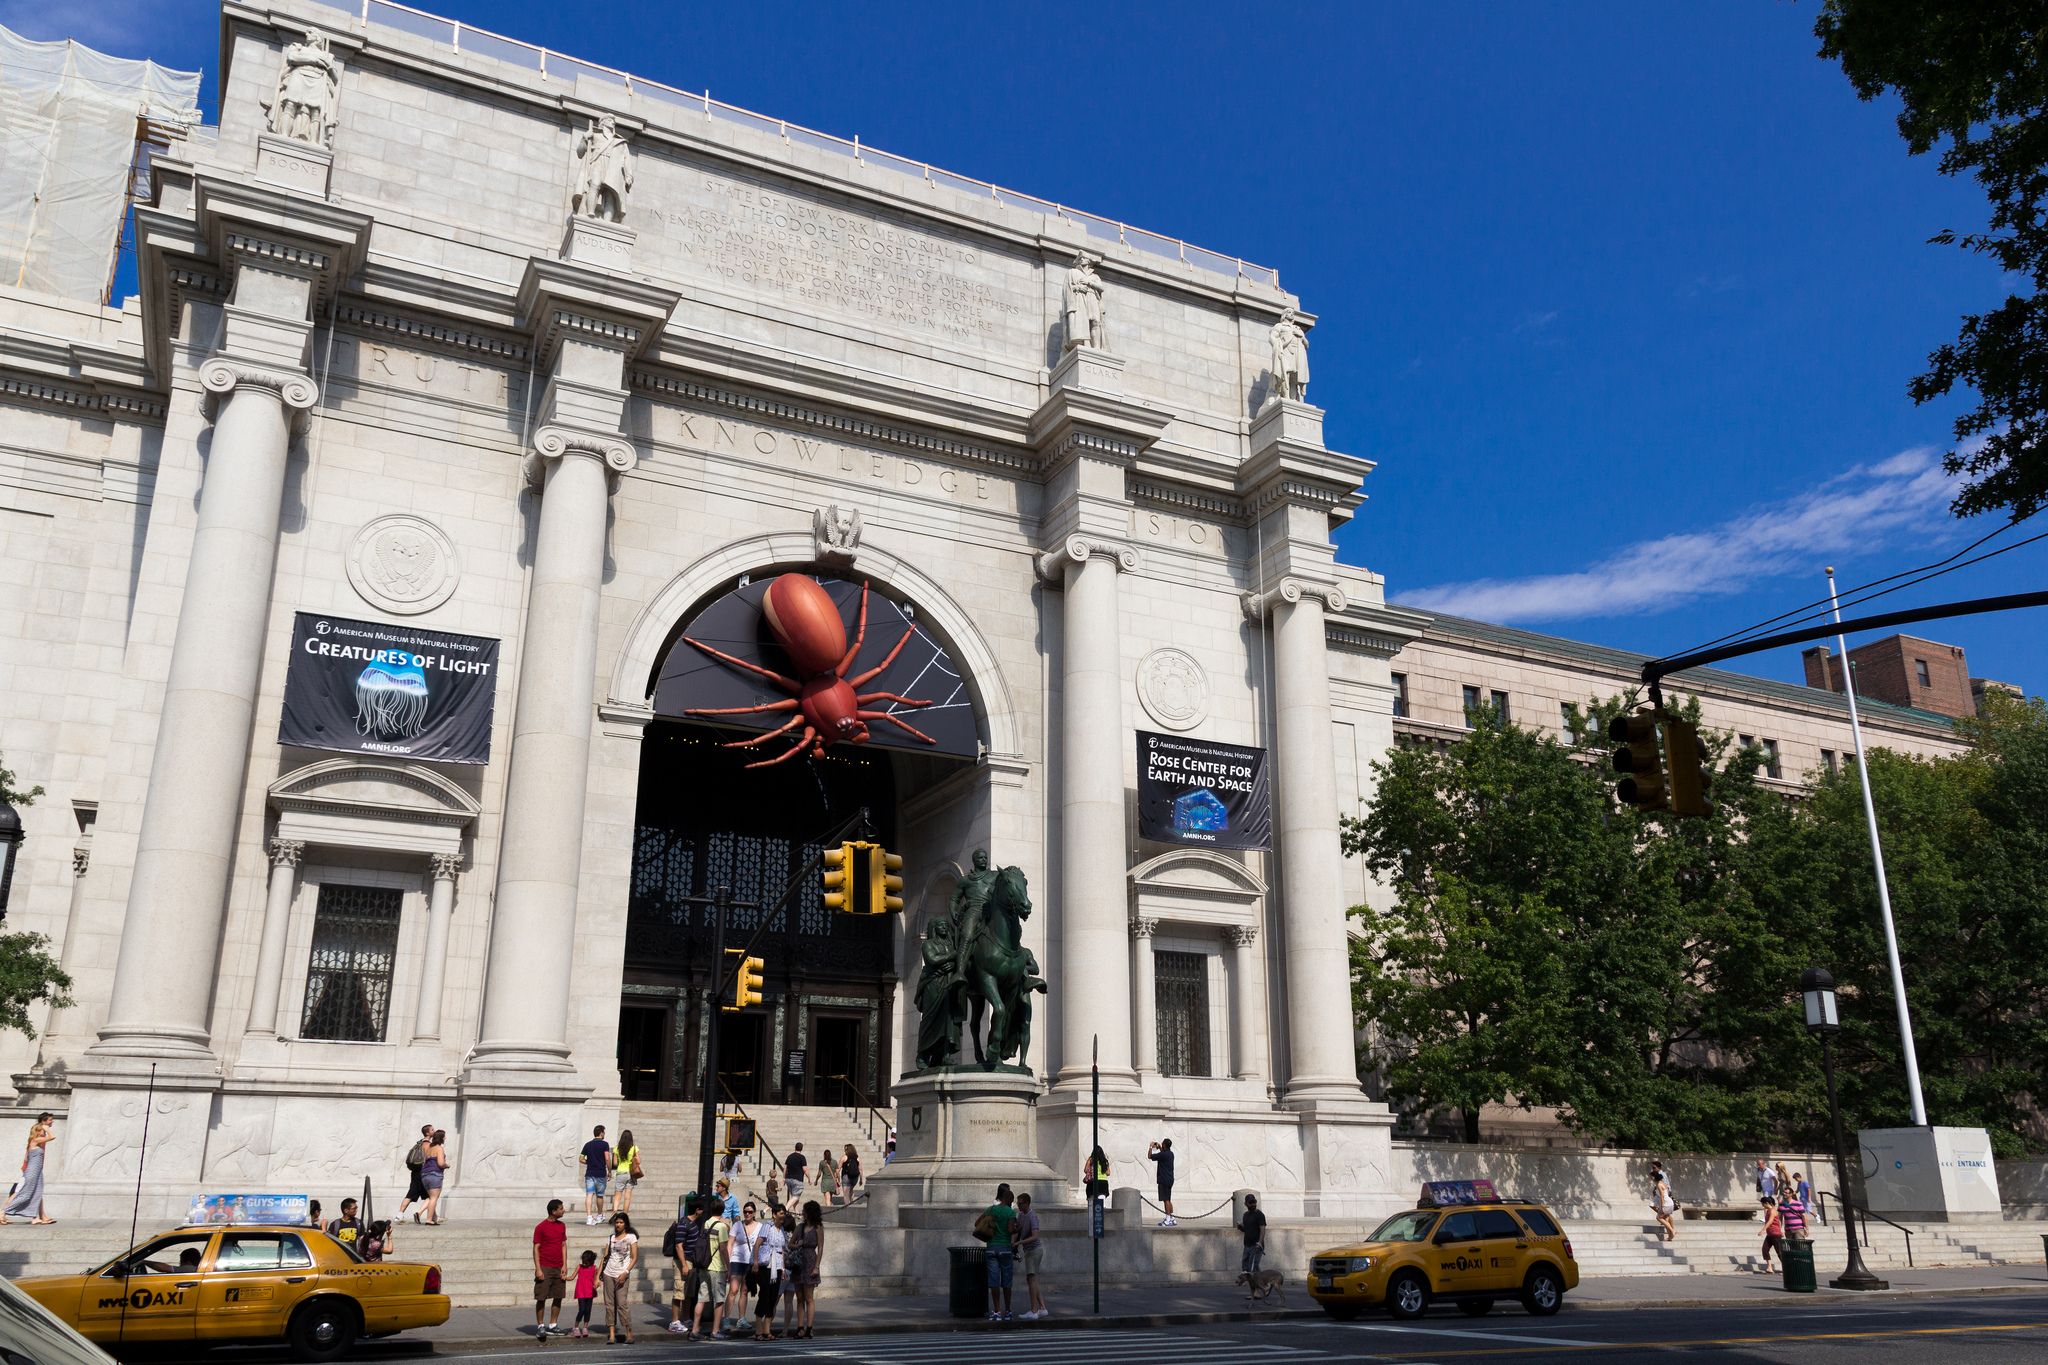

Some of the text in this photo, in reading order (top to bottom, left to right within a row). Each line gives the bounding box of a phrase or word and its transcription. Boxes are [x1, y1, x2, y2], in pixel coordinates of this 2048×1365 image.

[269, 156, 319, 176] BOONE
[705, 181, 975, 264] STATE OF NEW YORK MEMORIAL TO
[576, 235, 631, 256] AUDUBON
[740, 204, 945, 269] THEODORE ROOSEVELT
[650, 209, 1020, 316] IN ENERGY AND FORTITUDE IN THE FAITH OF OUR FATHERS
[700, 210, 745, 228] GREAT
[753, 224, 803, 248] LEADER
[810, 240, 827, 253] OF
[833, 246, 857, 260] THE
[866, 255, 909, 273] YOUTH
[916, 268, 931, 281] OF
[938, 273, 992, 296] AMERICA
[679, 242, 993, 333] IN THE LOVE AND CONSERVATION OF NATURE
[692, 233, 982, 318] IN DEFENSE OF THE RIGHTS OF THE PEOPLE
[705, 263, 969, 338] AND OF THE BEST IN LIFE AND IN MAN
[330, 339, 526, 403] TRUTH
[678, 413, 989, 500] KNOWLEDGE
[1131, 510, 1234, 550] ISION
[332, 626, 374, 640] AMERICAN
[375, 632, 409, 644] MUSEUM
[417, 638, 449, 649] NATURAL
[450, 642, 480, 652] HISTORY
[305, 637, 491, 676] CREATURES OF LIGHT
[361, 742, 411, 754] AMNH.ORG
[1159, 741, 1186, 751] AMERICAN
[1186, 745, 1208, 755] MUSEUM
[1213, 749, 1234, 758] NATURAL
[1235, 752, 1254, 760] HISTORY
[1150, 752, 1252, 778] ROSE CENTER FOR
[1148, 766, 1252, 793] EARTH AND SPACE
[1183, 832, 1216, 841] AMNH.ORG
[1957, 1160, 1987, 1168] ENTRANCE
[246, 1197, 274, 1207] GUYS
[280, 1197, 306, 1207] KIDS
[1441, 1256, 1483, 1271] NYC TAXI
[98, 1288, 184, 1310] NYC TAXI
